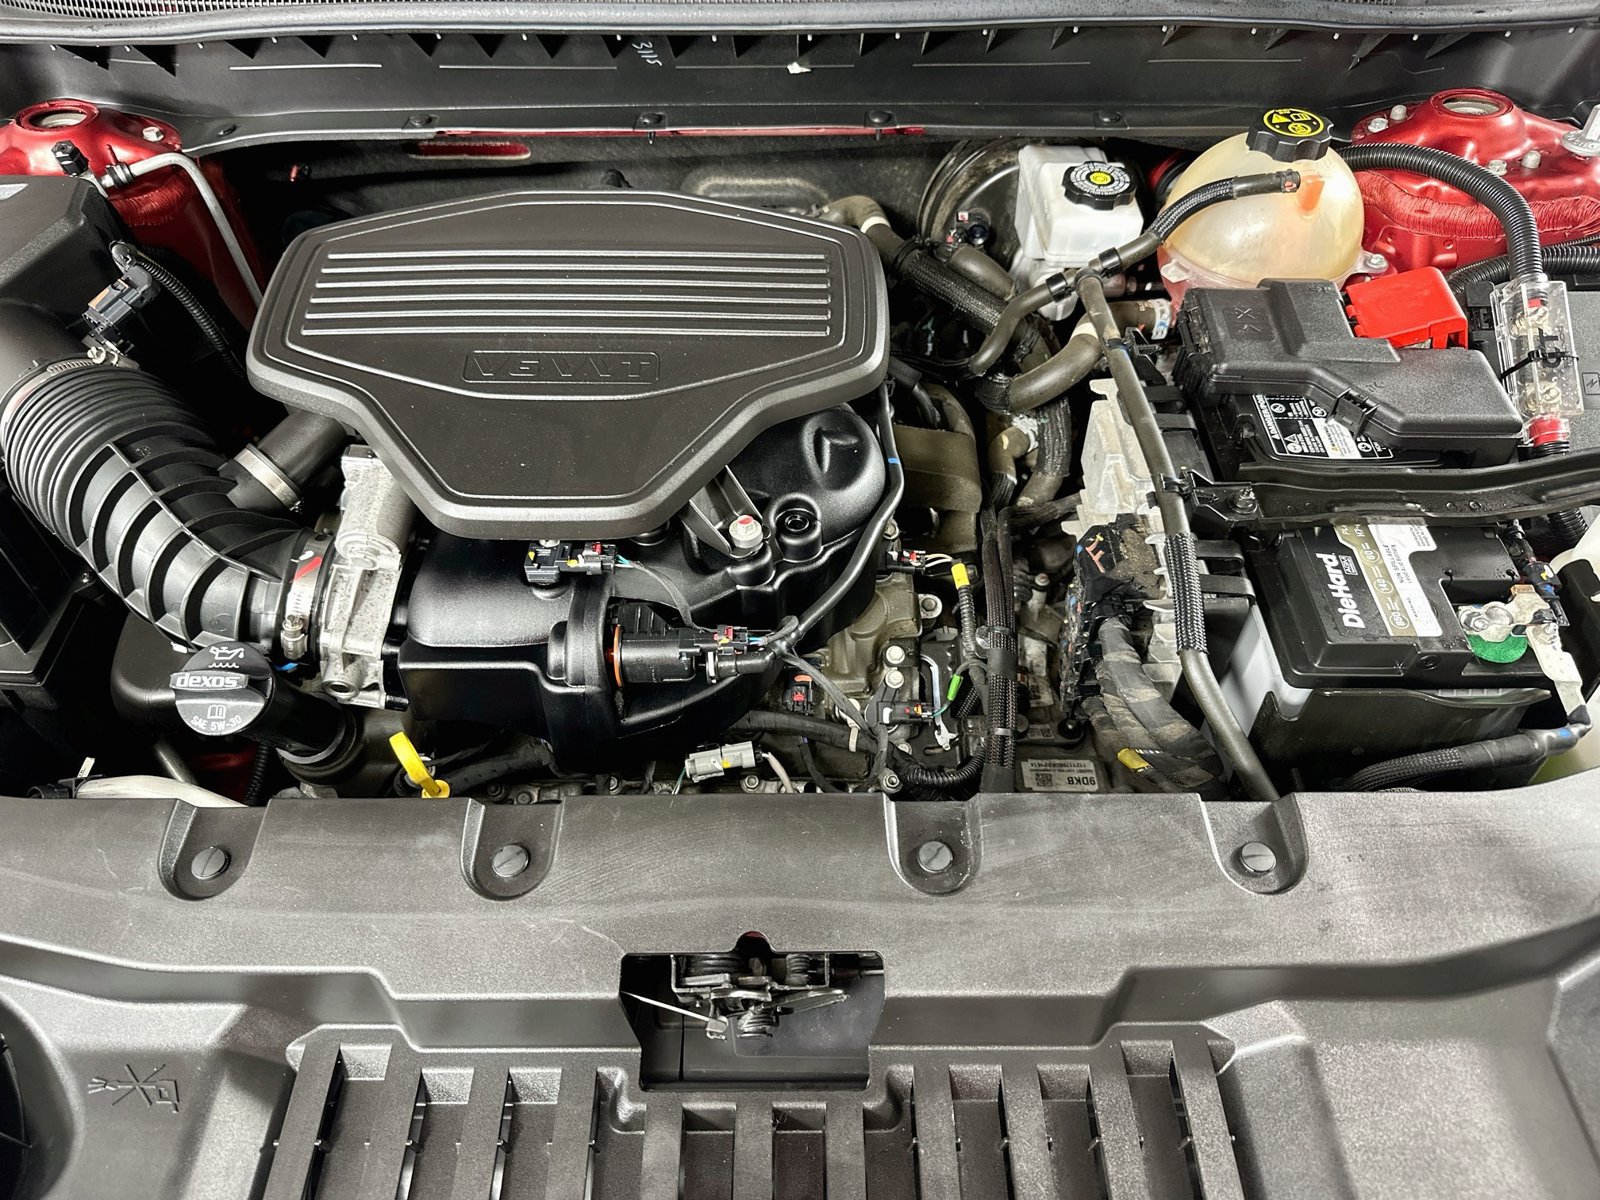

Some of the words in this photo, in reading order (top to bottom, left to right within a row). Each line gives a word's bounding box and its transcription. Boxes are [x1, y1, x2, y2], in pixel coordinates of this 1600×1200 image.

[473, 357, 540, 377] V6
[551, 357, 651, 378] VVT
[1316, 553, 1366, 629] DieHard
[176, 672, 241, 688] dexos
[191, 715, 208, 730] SAE
[210, 714, 242, 731] 5W-30
[1067, 776, 1096, 786] 9DKB
